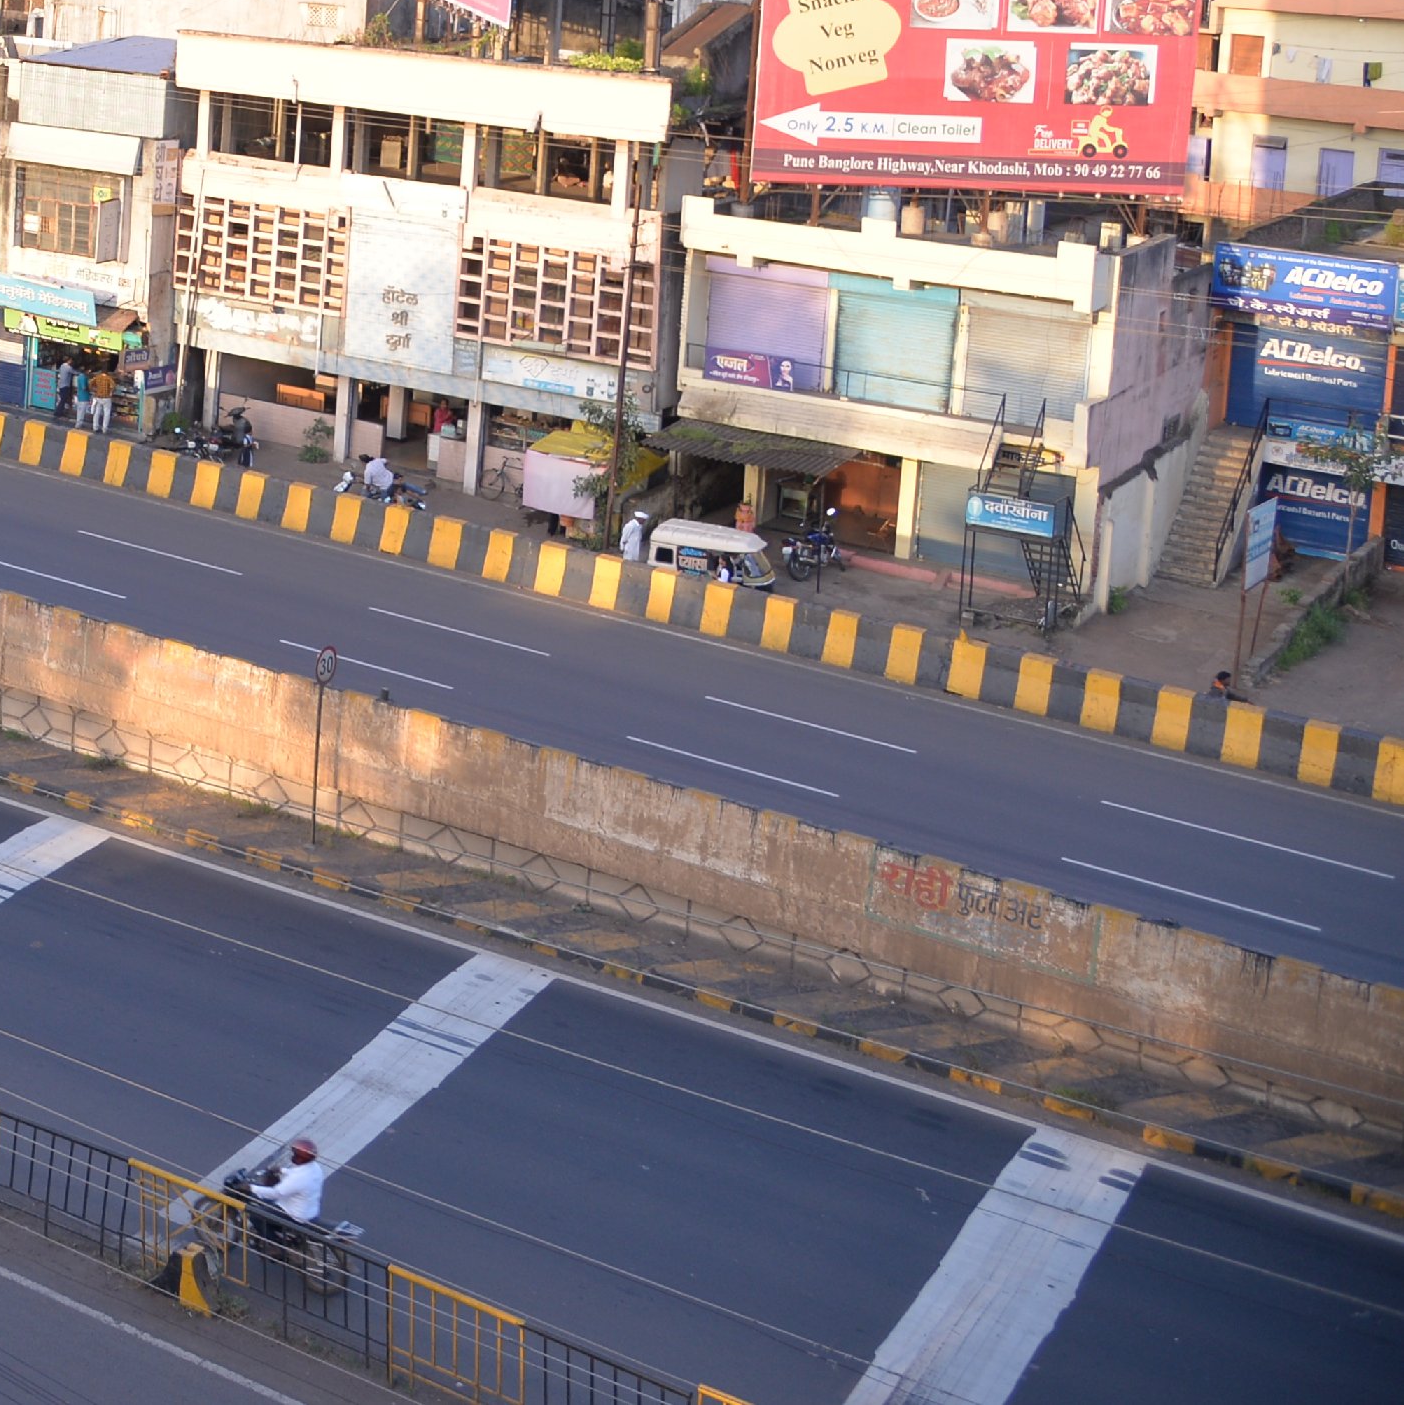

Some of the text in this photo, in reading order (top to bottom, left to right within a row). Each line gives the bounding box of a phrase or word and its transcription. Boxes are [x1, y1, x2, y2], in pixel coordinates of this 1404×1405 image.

[820, 22, 855, 39] Veg
[809, 49, 880, 74] Nonveg
[787, 116, 888, 134] Only 2.5 K.M.
[897, 122, 975, 136] Clean Toilet
[1034, 138, 1073, 149] DELIVERY
[783, 153, 815, 168] Pune
[818, 154, 874, 173] Banglore
[967, 160, 1031, 177] Khodashi,
[1033, 163, 1063, 177] Mob
[1074, 163, 1089, 177] 90
[1091, 164, 1107, 178] 49
[1110, 165, 1124, 178] 22
[1128, 165, 1143, 179] 77
[1146, 166, 1160, 179] 66
[1284, 266, 1384, 296] ACDelco
[382, 285, 418, 306] हॉटेल
[391, 311, 409, 327] श्री
[984, 500, 1048, 522] दवाखाना
[879, 862, 953, 910] राही
